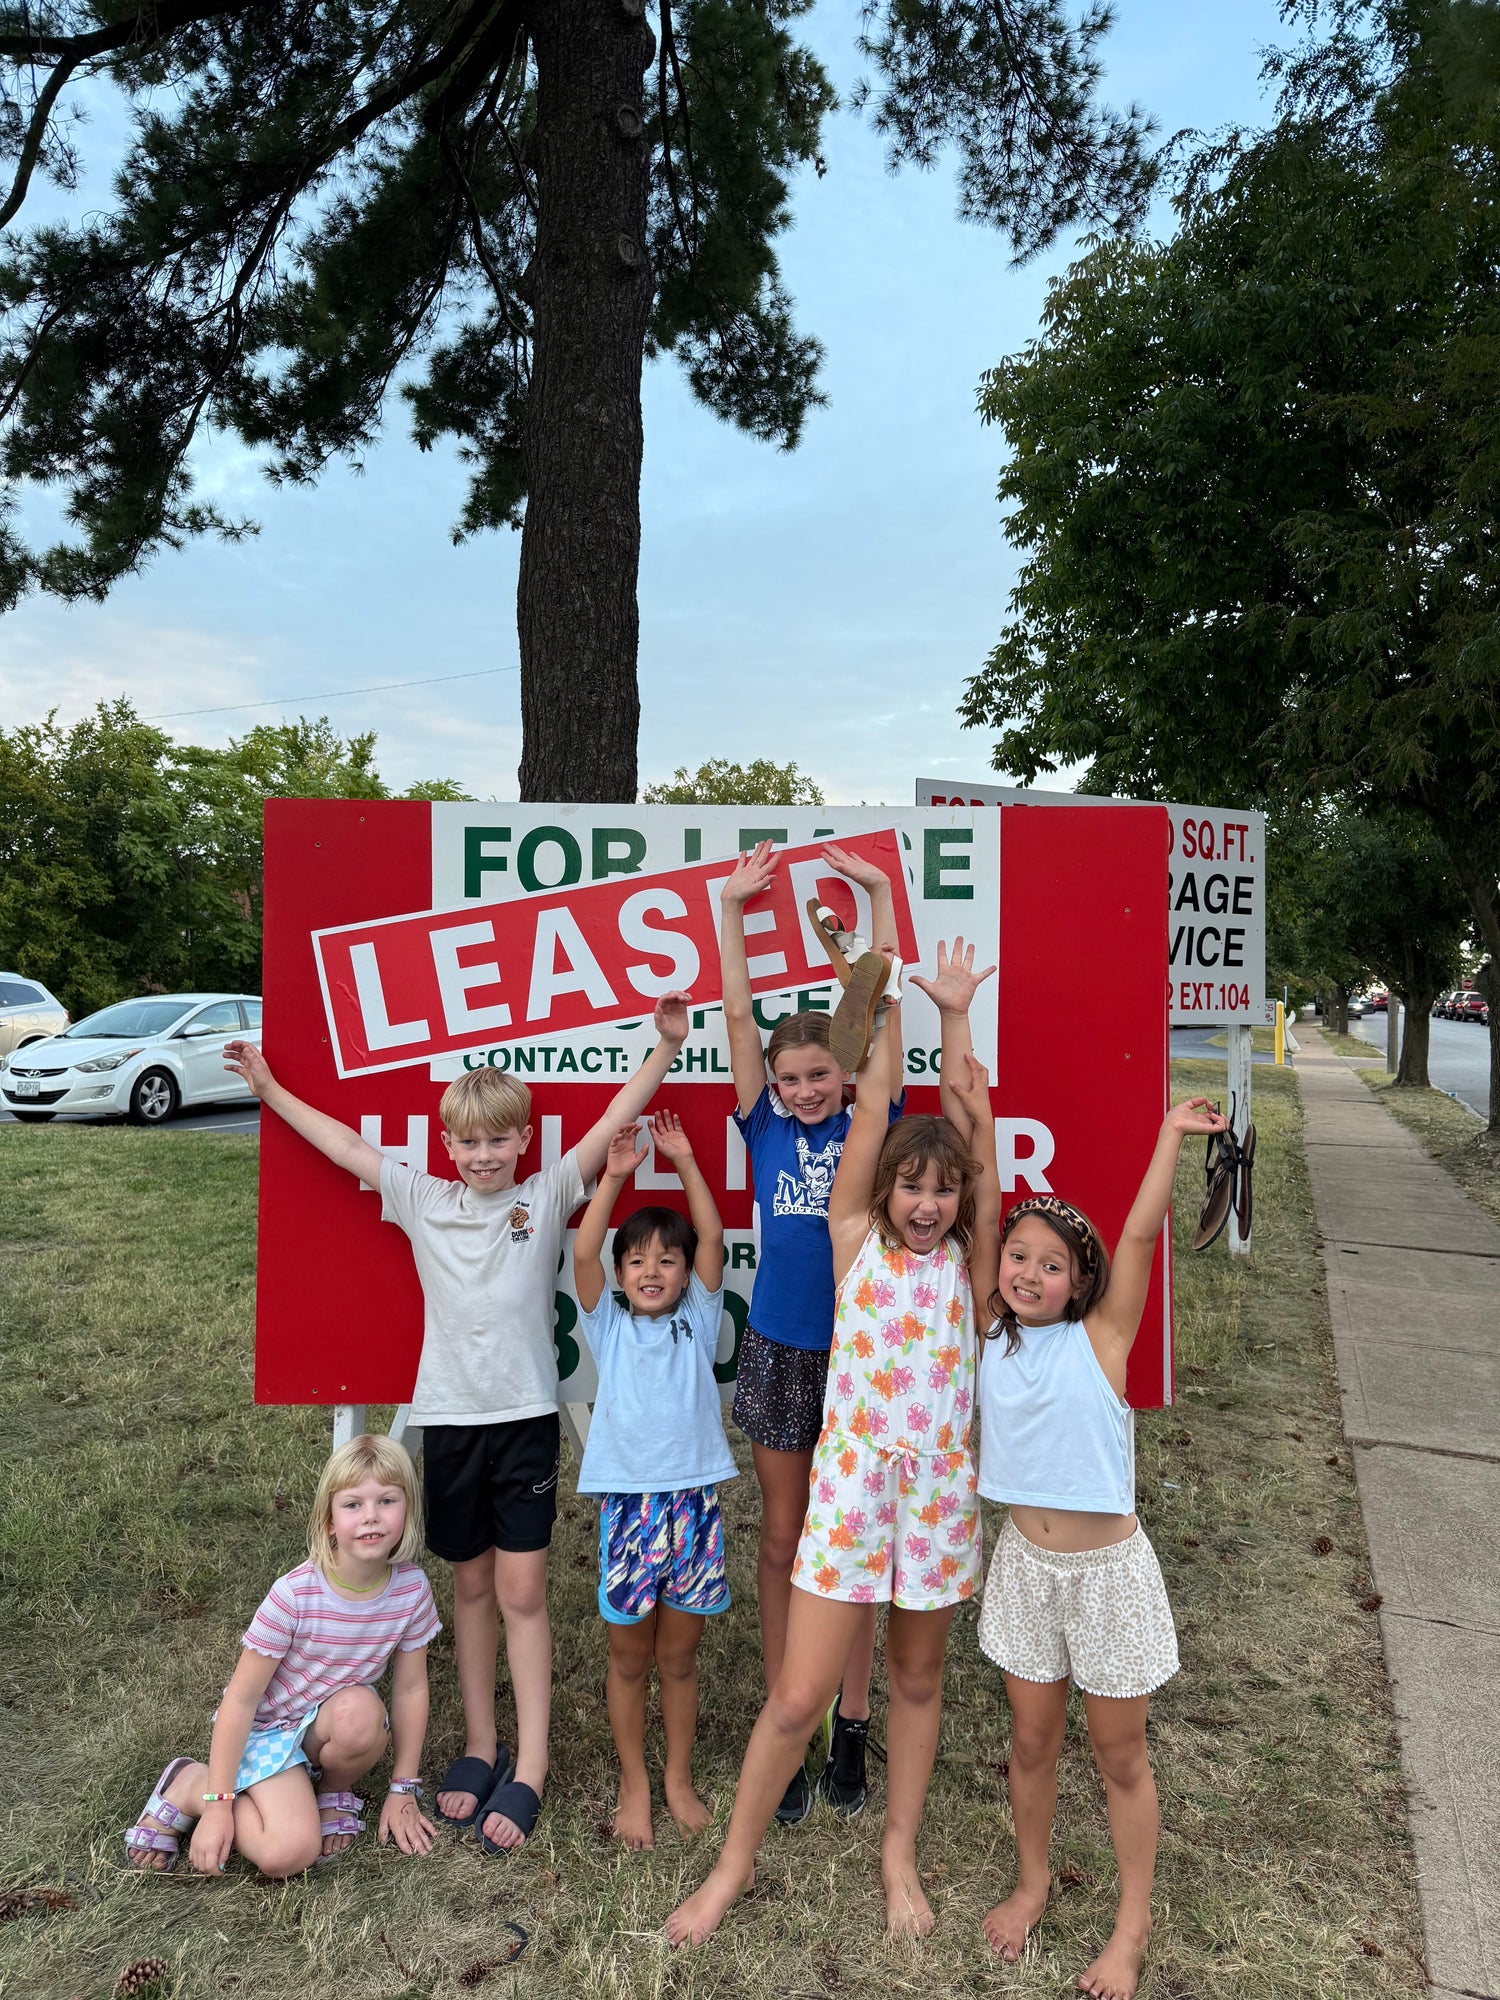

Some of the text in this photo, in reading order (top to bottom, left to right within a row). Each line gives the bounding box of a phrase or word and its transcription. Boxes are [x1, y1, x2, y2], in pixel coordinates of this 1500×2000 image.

[464, 825, 647, 898] FOR
[1182, 818, 1254, 862] SQ.FT.
[349, 857, 874, 1051] LEASED
[1180, 982, 1250, 1011] EXT.104
[463, 1047, 628, 1073] CONTACT:
